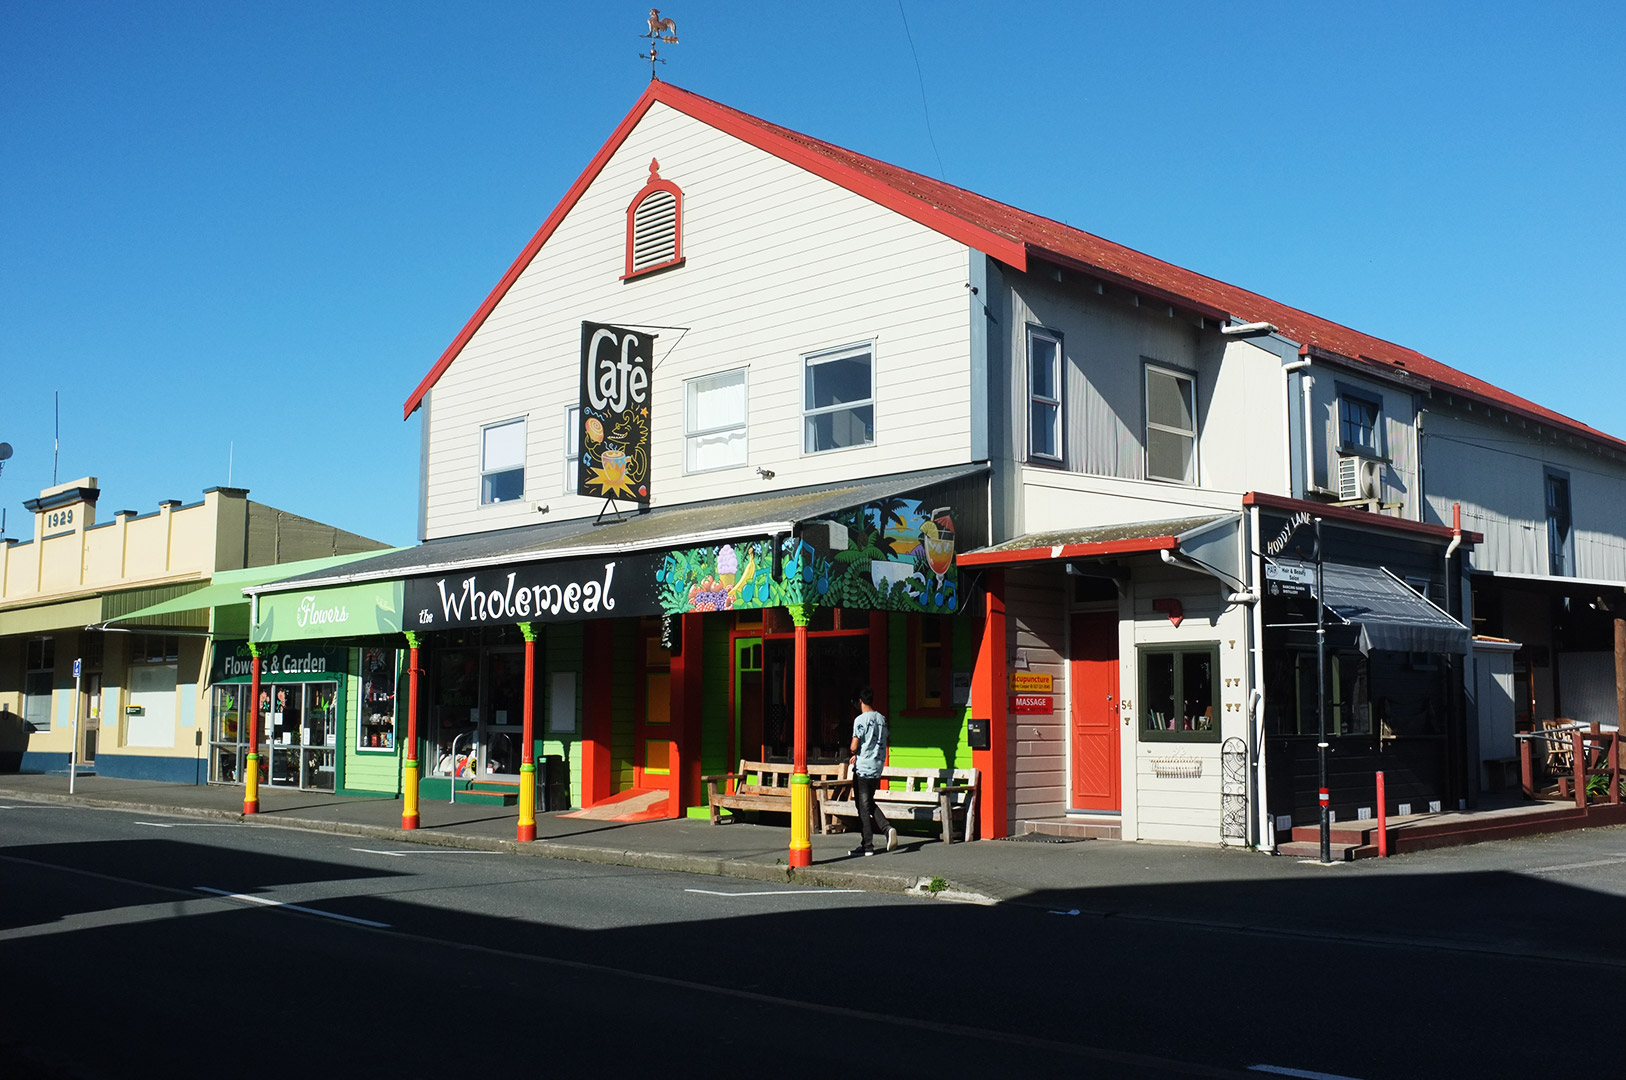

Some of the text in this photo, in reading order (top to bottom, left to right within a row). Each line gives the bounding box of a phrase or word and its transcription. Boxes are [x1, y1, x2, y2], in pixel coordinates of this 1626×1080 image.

[48, 509, 73, 528] 1929
[1267, 511, 1311, 555] HODDY LANE
[418, 562, 616, 624] the Wholemeal
[296, 595, 350, 628] Flowers
[225, 653, 326, 675] Flowes & Garden
[1012, 674, 1049, 684] Acupuncture
[1015, 698, 1046, 707] MASSAGE
[1121, 700, 1133, 710] 54
